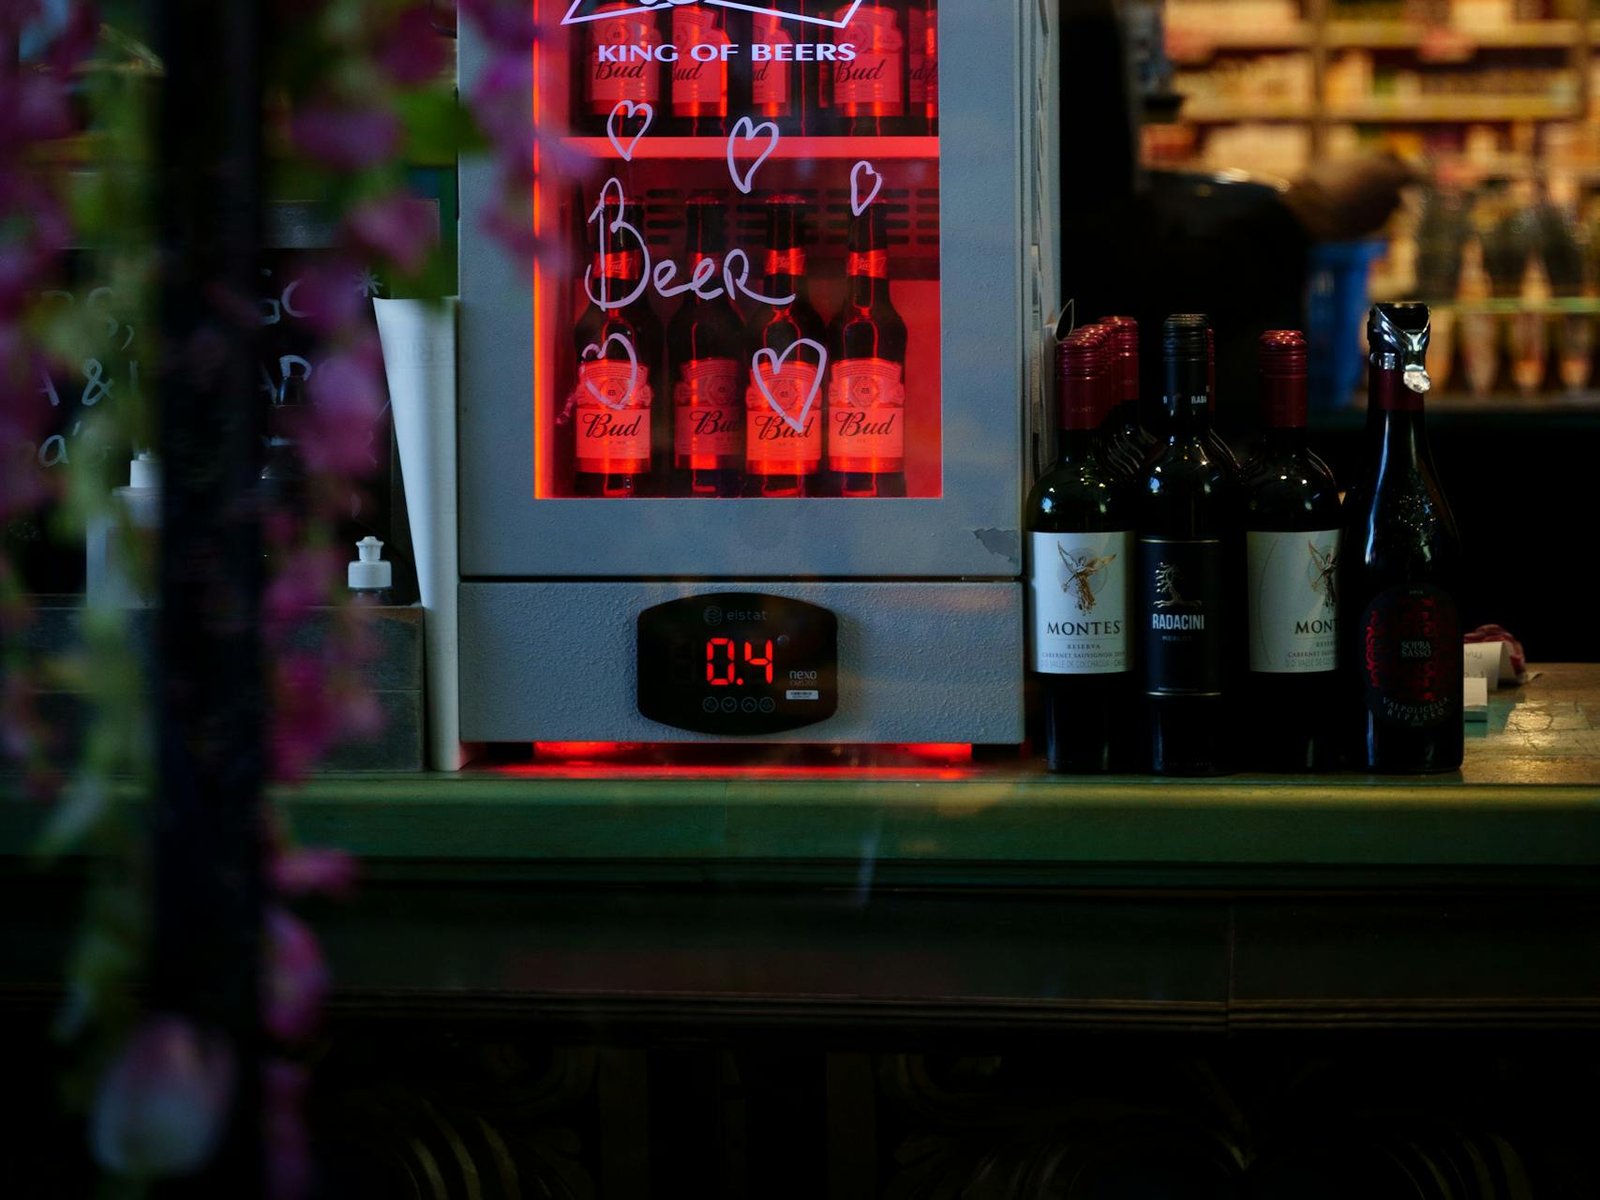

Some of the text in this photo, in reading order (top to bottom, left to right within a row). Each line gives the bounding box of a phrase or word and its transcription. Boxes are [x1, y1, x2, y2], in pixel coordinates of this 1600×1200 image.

[598, 42, 857, 62] KING OF BEERS
[834, 58, 886, 83] Bud
[582, 410, 643, 440] Bud
[689, 410, 738, 435] Bu
[755, 416, 813, 441] Bud
[835, 411, 896, 438] Bud
[1046, 619, 1121, 636] MONTES
[1151, 613, 1206, 631] RADACINI
[706, 636, 775, 688] 0.4
[788, 669, 818, 680] nexo
